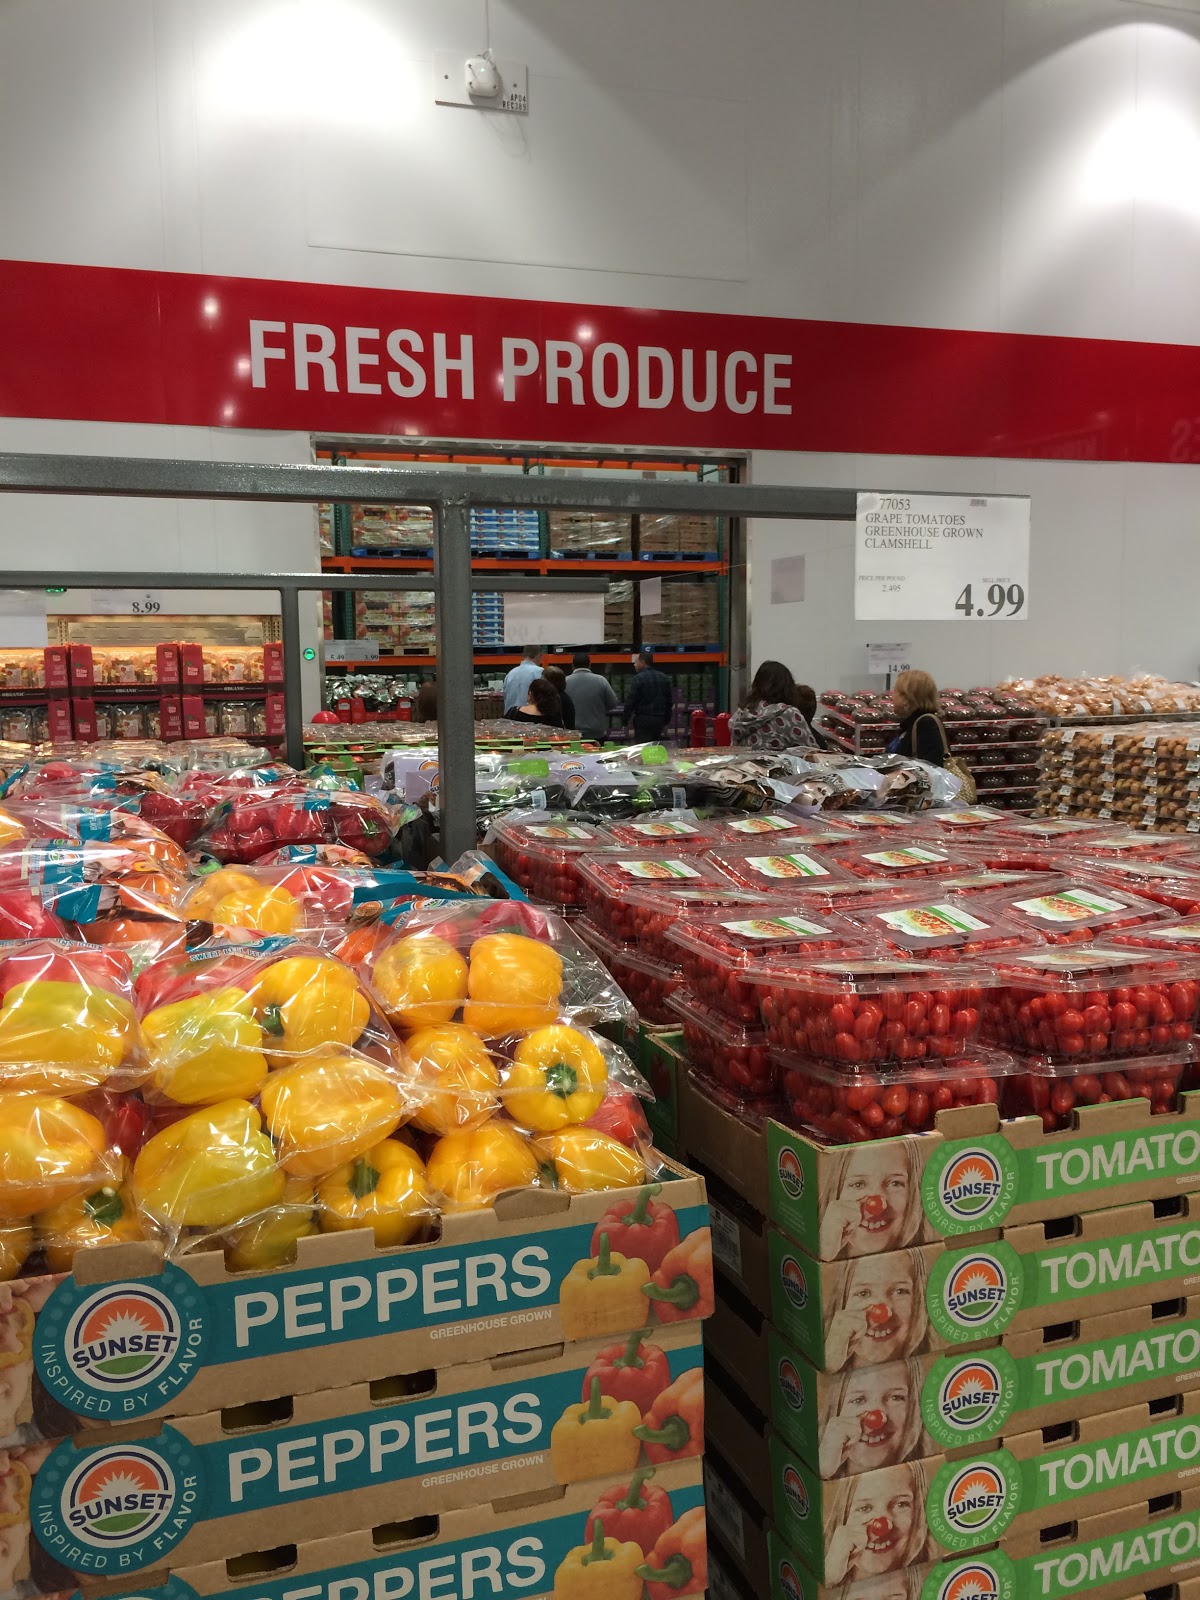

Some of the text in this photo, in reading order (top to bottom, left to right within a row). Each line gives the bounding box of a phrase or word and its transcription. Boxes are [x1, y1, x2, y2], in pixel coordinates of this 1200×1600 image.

[510, 93, 526, 103] AP04
[249, 319, 793, 415] FRESH PRODUCE
[865, 513, 966, 525] GRAPE TOMATOES
[879, 498, 911, 511] 77053
[865, 526, 984, 539] GREENHOUSE GROWN
[865, 538, 933, 550] CLAMSHELL
[132, 601, 161, 613] 8.99
[955, 583, 1025, 617] 4.99
[1036, 1129, 1200, 1190] TOMATO
[779, 1168, 805, 1191] SUNSET
[943, 1182, 1001, 1204] SUNSET
[926, 1186, 964, 1235] INSPIRED
[988, 1172, 1015, 1224] FLAVOR
[234, 1245, 552, 1348] PEPPERS
[931, 1276, 1020, 1341] INSPIRED BY FLAVOR
[948, 1287, 1006, 1311] SUNSET
[430, 1309, 553, 1341] GREENHOUSE GROWN
[41, 1317, 203, 1413] INSPIRED BY FLAVOR
[73, 1334, 177, 1369] SUNSET
[1036, 1328, 1200, 1396] TOMATO
[926, 1379, 1014, 1445] INSPIRED BY FLAVOR
[942, 1391, 1000, 1416] SUNSET
[228, 1392, 543, 1503] PEPPERS
[1039, 1424, 1200, 1497] TOMATO
[421, 1454, 544, 1489] GREENHOUSE GROWN
[38, 1475, 198, 1568] INSPIRED BY FLAVOR
[69, 1493, 172, 1527] SUNSET
[931, 1481, 1019, 1547] INSPIRED BY FLAVOR
[947, 1494, 1004, 1520] SUNSET
